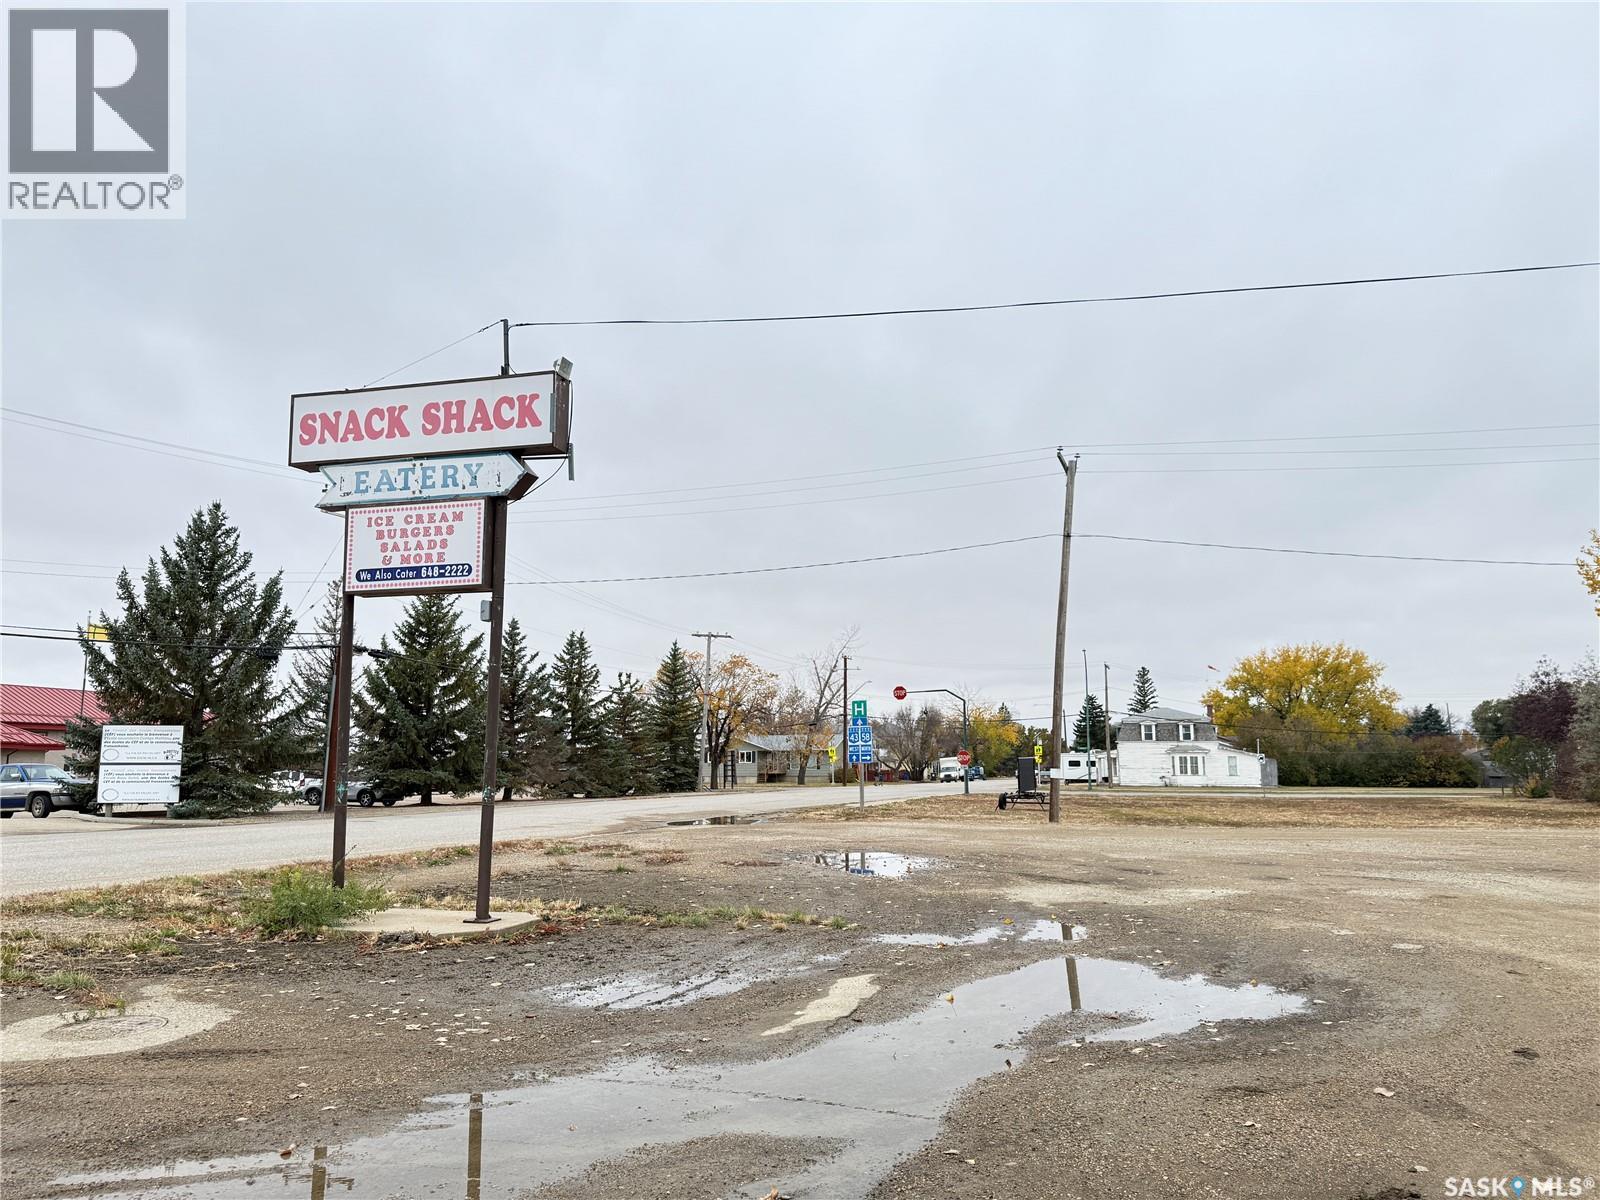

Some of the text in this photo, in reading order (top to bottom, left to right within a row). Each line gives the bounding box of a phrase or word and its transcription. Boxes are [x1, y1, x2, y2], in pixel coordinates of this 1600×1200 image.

[299, 393, 542, 446] SNACK SHACK
[354, 462, 484, 494] EATERY
[367, 510, 464, 528] ICE CREAM
[375, 525, 455, 540] BURGERS
[380, 538, 449, 553] SALADS
[381, 552, 446, 566] & MORE
[360, 564, 469, 581] We Also Cater 648-2222
[894, 689, 906, 697] STOP
[854, 703, 864, 716] H
[849, 733, 870, 742] 43 58
